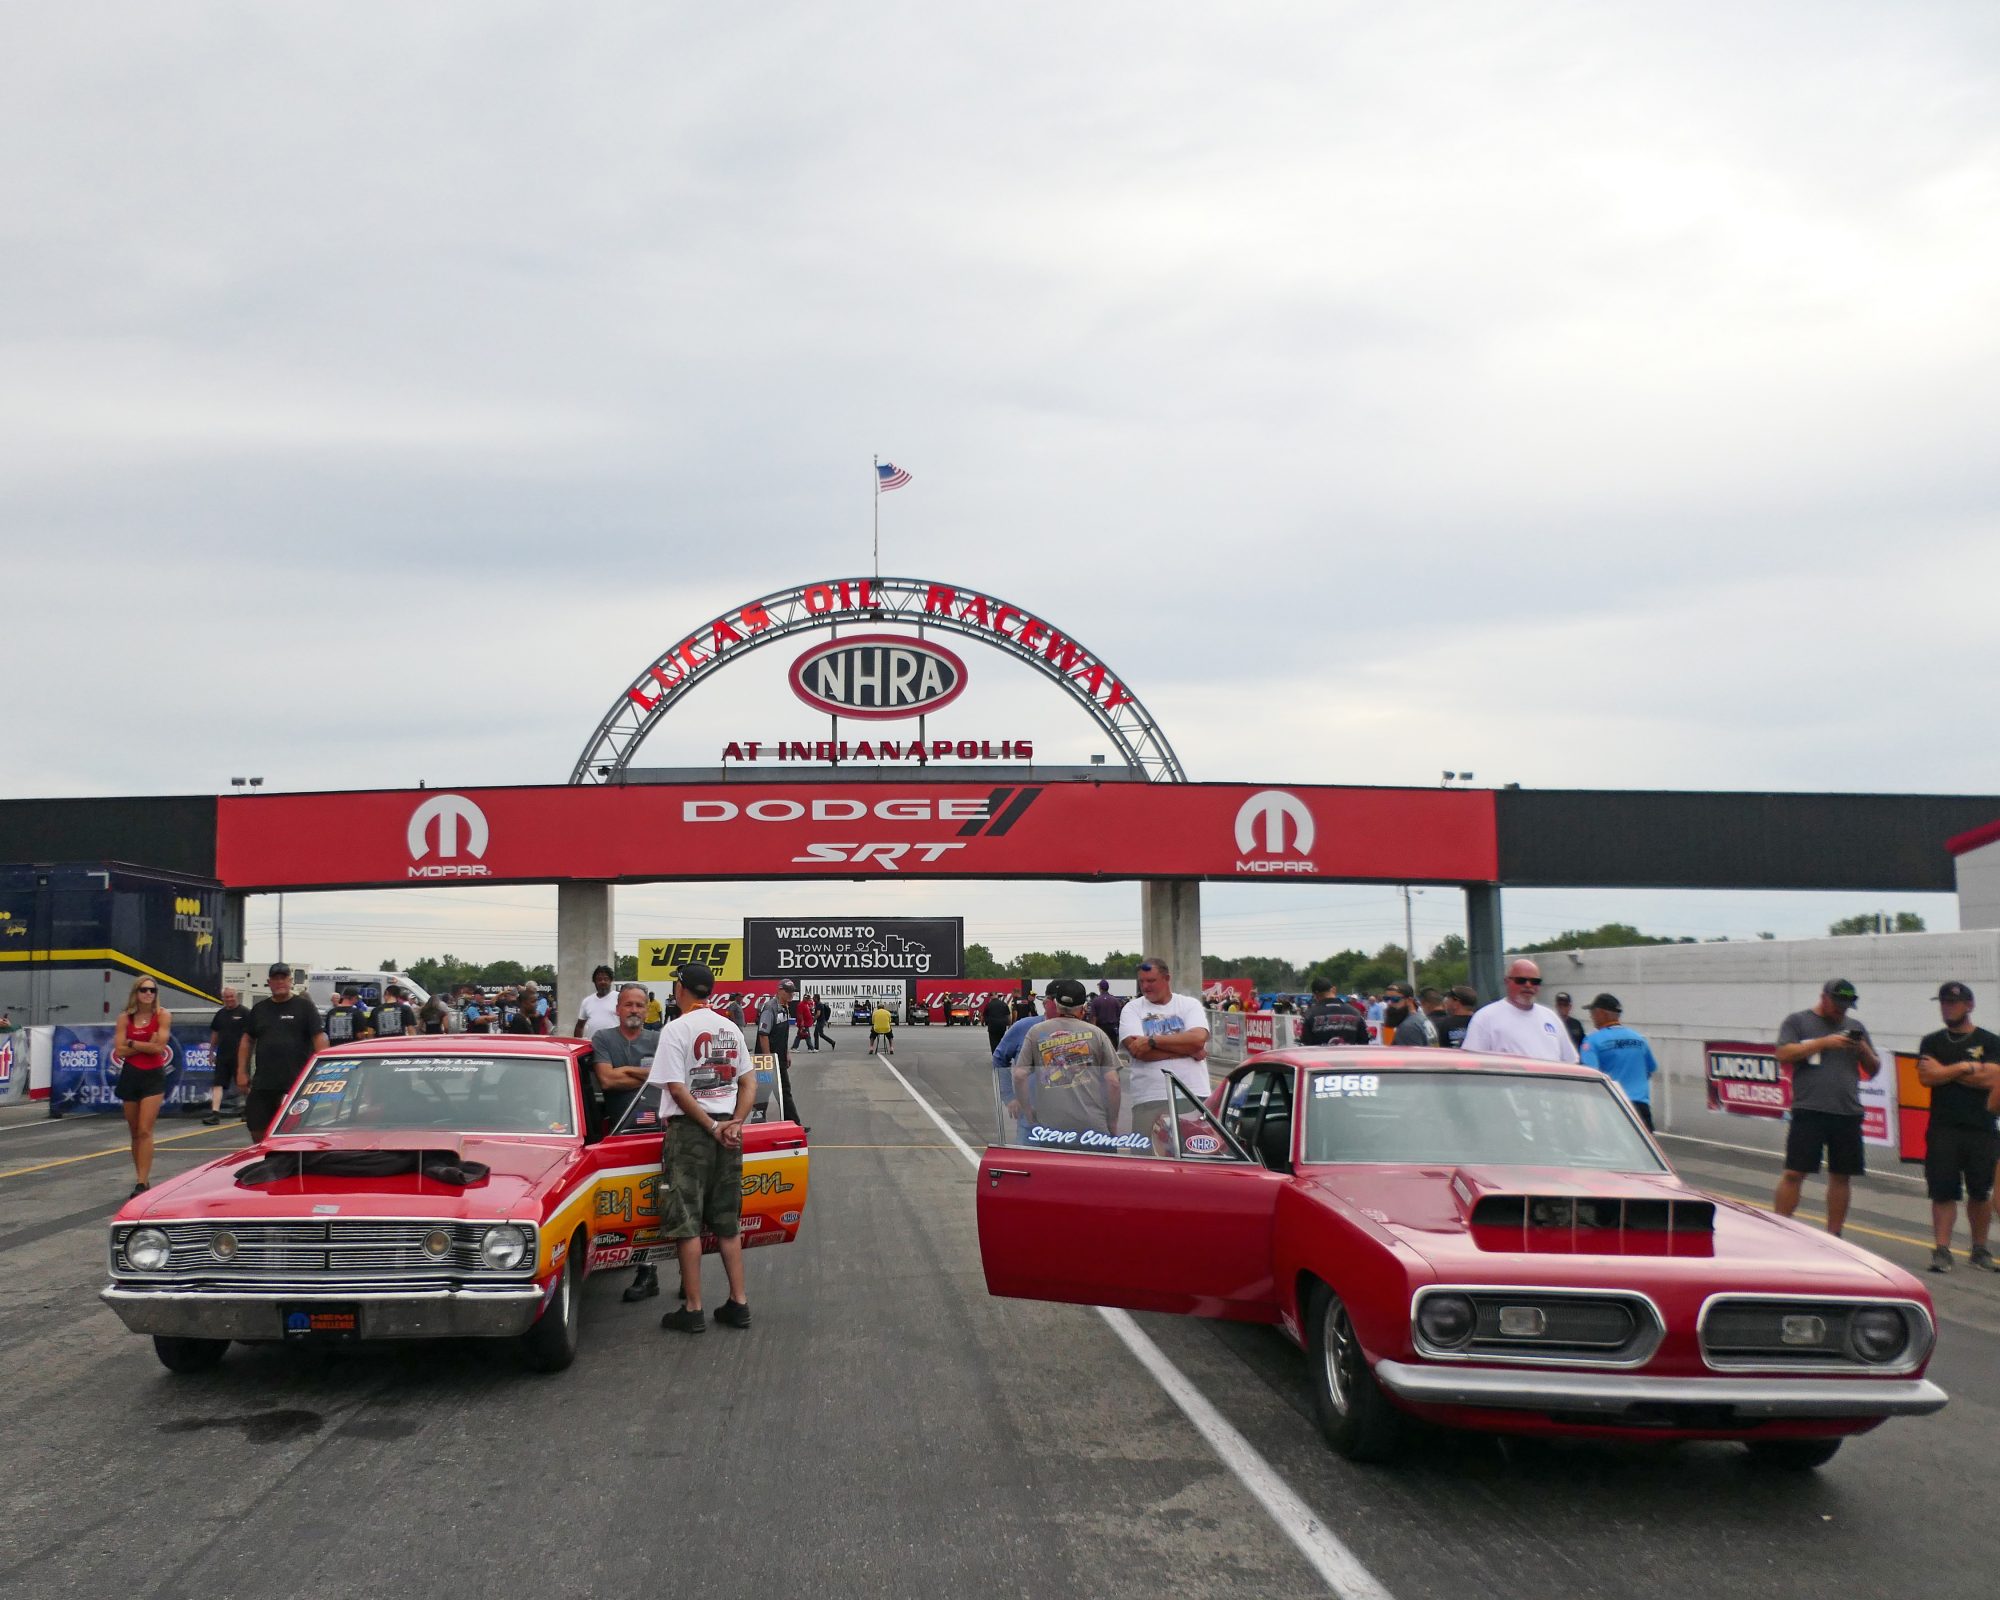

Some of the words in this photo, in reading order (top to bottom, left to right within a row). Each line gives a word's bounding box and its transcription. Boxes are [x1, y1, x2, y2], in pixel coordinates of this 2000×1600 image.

[629, 602, 771, 712] LUCAS
[804, 580, 881, 615] OIL
[924, 584, 1134, 712] RACEWAY
[817, 648, 944, 707] NHRA
[721, 741, 763, 761] AT
[778, 740, 1033, 762] INDIANAPOLIS
[683, 799, 991, 822] DODGE
[791, 843, 967, 870] SRT
[408, 865, 489, 877] MOPAR
[1236, 861, 1315, 872] MOPAR
[775, 927, 853, 939] WELCOME
[854, 927, 875, 938] TO
[651, 943, 731, 966] JEGS
[796, 944, 831, 952] TOWN
[836, 944, 852, 952] OF
[777, 948, 931, 973] Brownsburg
[804, 985, 858, 996] MILLENNIUM
[861, 985, 902, 995] TRAILERS
[1247, 1020, 1262, 1037] LUCAS
[1263, 1020, 1272, 1037] OIL
[59, 1050, 98, 1059] CAMPING
[59, 1058, 98, 1067] WORLD
[1711, 1055, 1777, 1081] LINCOLN
[302, 1080, 347, 1095] 1058
[1313, 1075, 1379, 1092] 1968
[171, 1085, 197, 1104] ALL
[1725, 1082, 1784, 1104] WELDERS
[1028, 1126, 1077, 1143] Steve
[1080, 1129, 1150, 1149] Comella
[1190, 1137, 1217, 1151] NHRA
[596, 1249, 630, 1263] MSD
